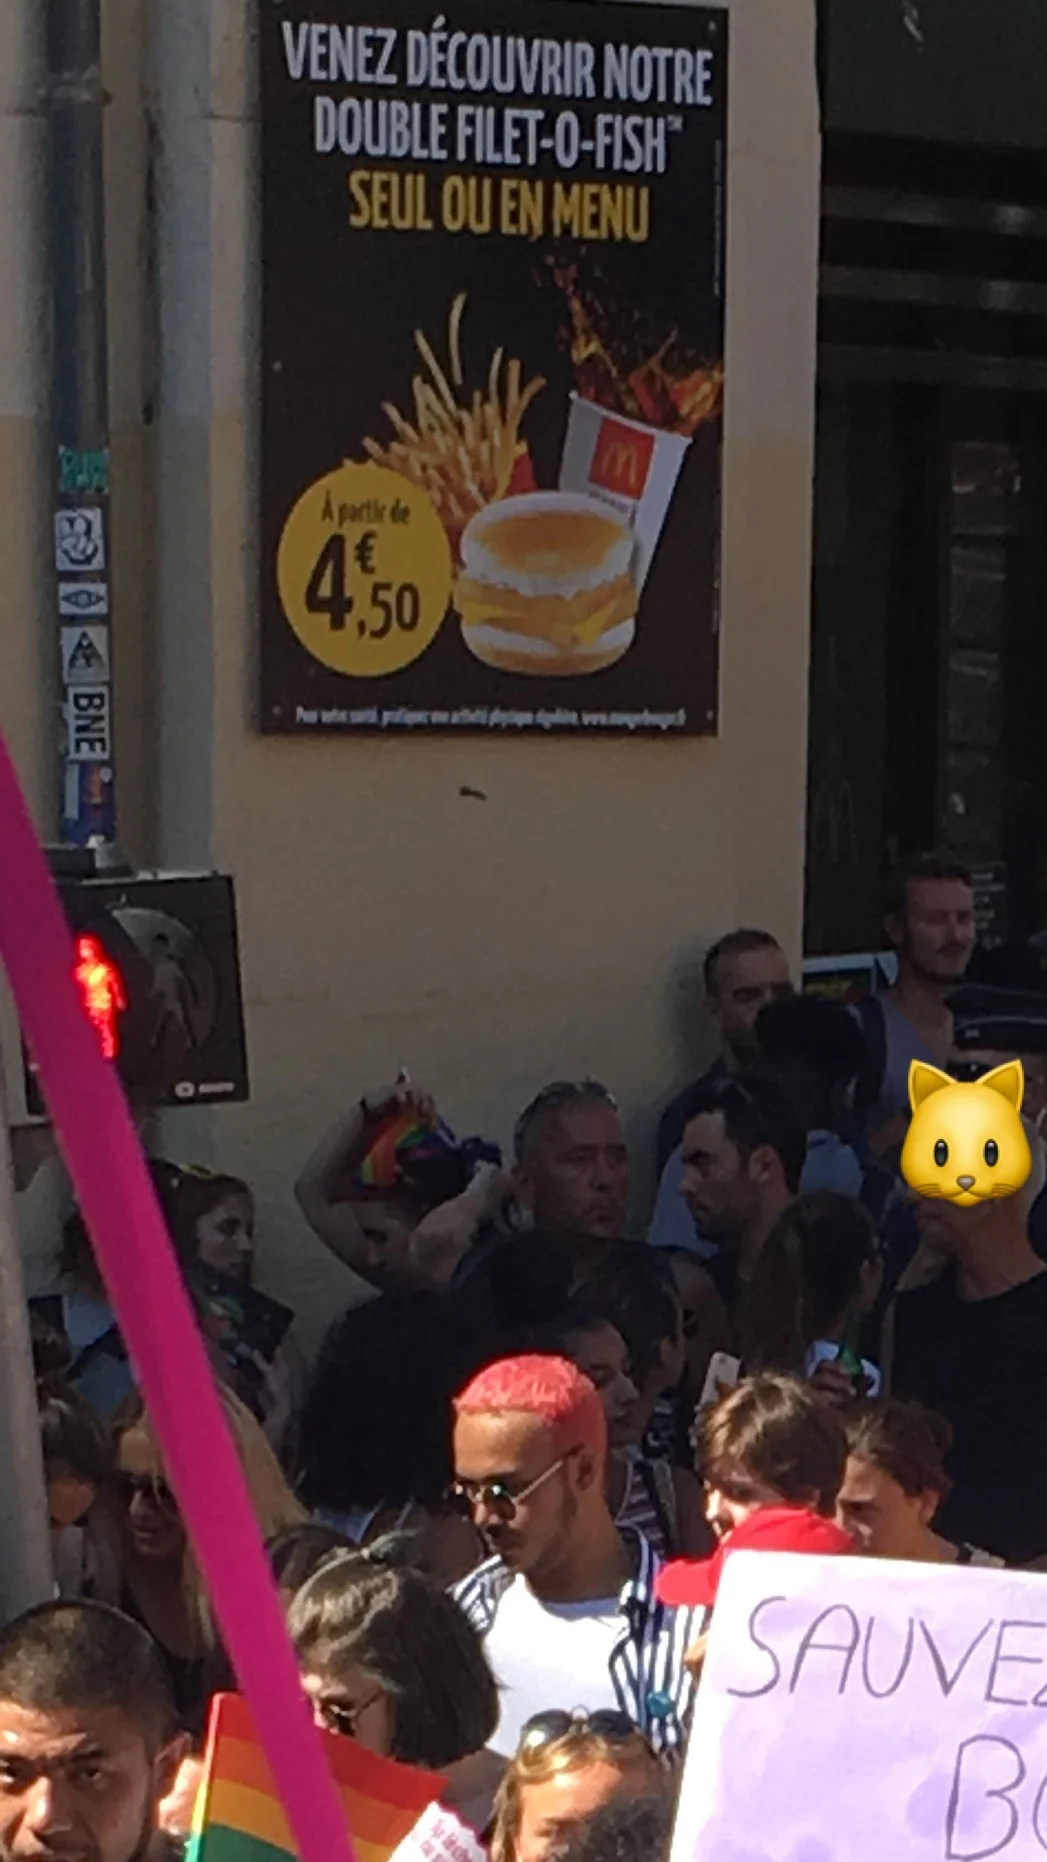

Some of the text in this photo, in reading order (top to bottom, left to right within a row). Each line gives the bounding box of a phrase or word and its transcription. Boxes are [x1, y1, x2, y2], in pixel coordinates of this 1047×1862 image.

[281, 14, 713, 106] VENEZ DÉCOUVRIR NOTRE
[313, 95, 448, 161] DOUBLE
[348, 169, 650, 242] SEUL OU EN MENU
[390, 498, 410, 524] de
[73, 693, 107, 754] BNE
